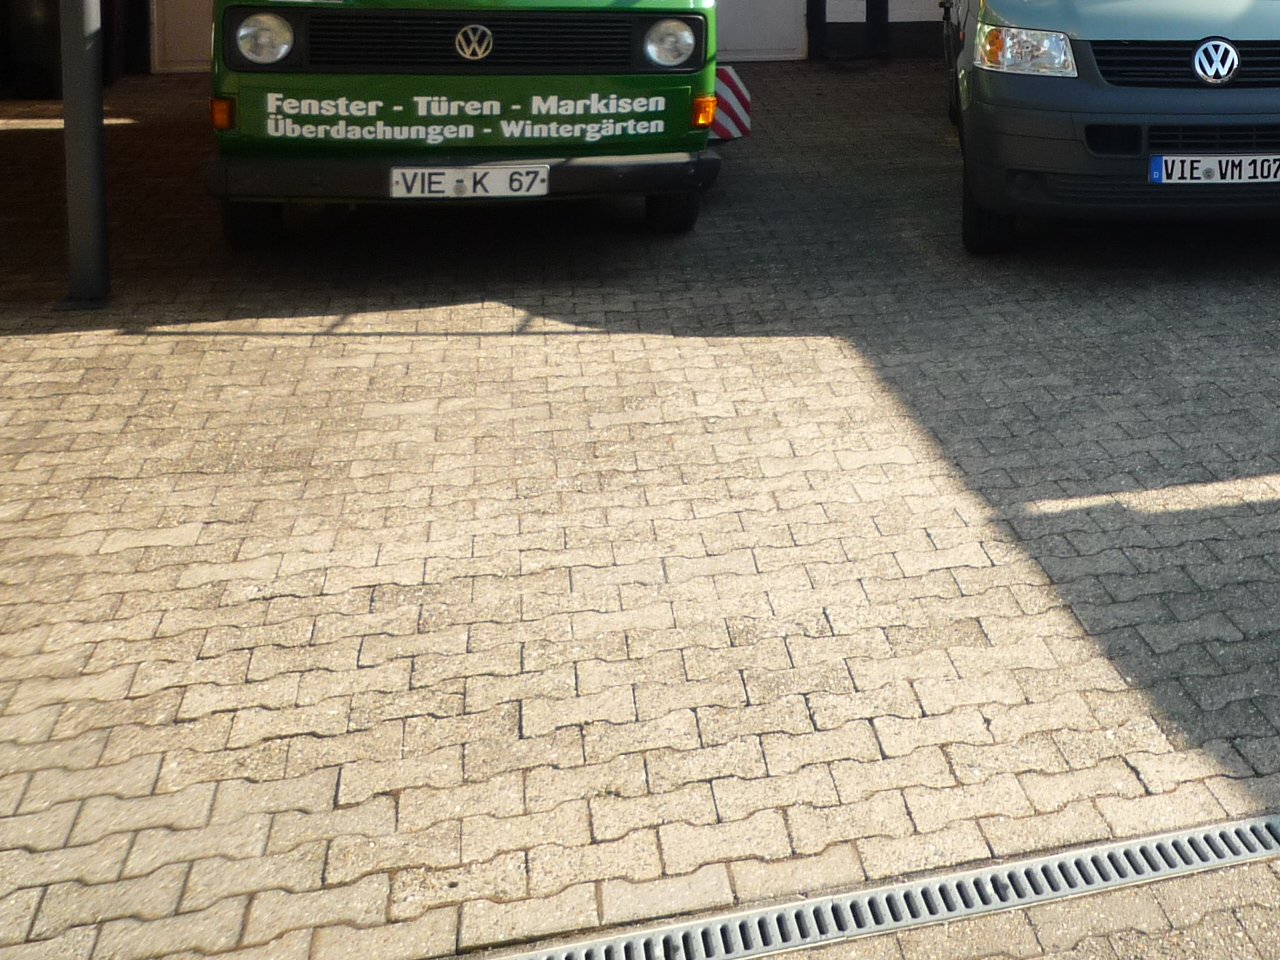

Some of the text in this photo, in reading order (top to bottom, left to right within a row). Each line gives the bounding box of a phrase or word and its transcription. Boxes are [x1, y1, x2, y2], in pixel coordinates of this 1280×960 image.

[267, 93, 384, 116] Fenster
[413, 96, 501, 116] Türen
[531, 93, 666, 115] Markisen
[267, 114, 474, 144] Überdachungen
[500, 119, 665, 142] Wintergärten
[1164, 159, 1202, 180] VIE
[1218, 159, 1243, 180] VM
[401, 170, 540, 194] VIE K 67
